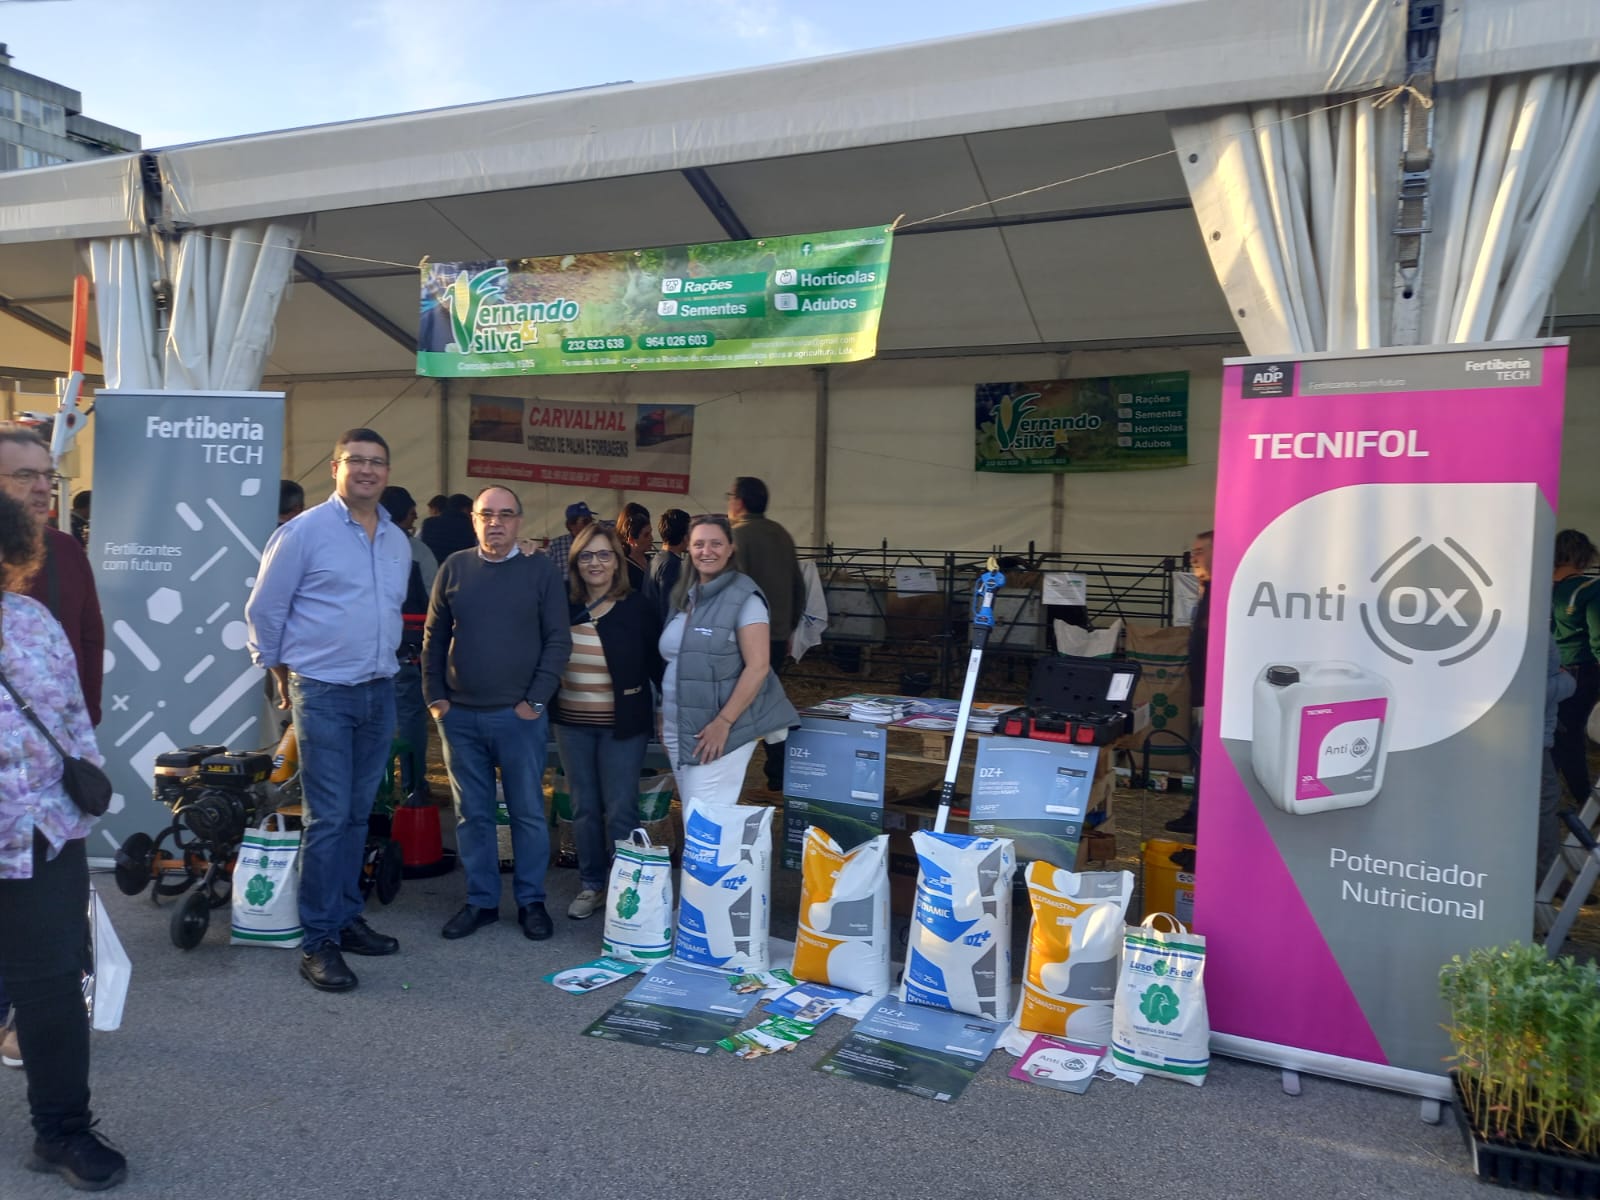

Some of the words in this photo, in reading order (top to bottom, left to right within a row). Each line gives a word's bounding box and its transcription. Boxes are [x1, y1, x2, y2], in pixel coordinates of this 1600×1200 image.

[684, 279, 733, 293] Rações
[681, 302, 747, 317] Sementes
[802, 297, 857, 312] Adubos
[567, 340, 586, 351] 232
[586, 339, 605, 350] 623
[645, 337, 665, 347] 964
[667, 336, 686, 347] 026
[688, 334, 708, 345] 603
[1465, 357, 1531, 372] Fertiberia
[1252, 371, 1284, 384] ADP
[1495, 370, 1530, 381] TECH
[529, 406, 627, 432] CARVALHAL
[146, 415, 264, 440] Fertiberia
[1248, 429, 1430, 460] TECNIFOL
[201, 444, 263, 465] TECH
[104, 542, 182, 557] Fertilizantes
[102, 560, 128, 571] com
[130, 558, 172, 572] futuro
[1247, 581, 1346, 621] Anti
[1324, 743, 1348, 756] Anti
[980, 767, 1005, 778] DZ+
[1330, 847, 1489, 889] Potenciador
[1341, 879, 1485, 921] Nutricional
[1129, 961, 1152, 972] Luso
